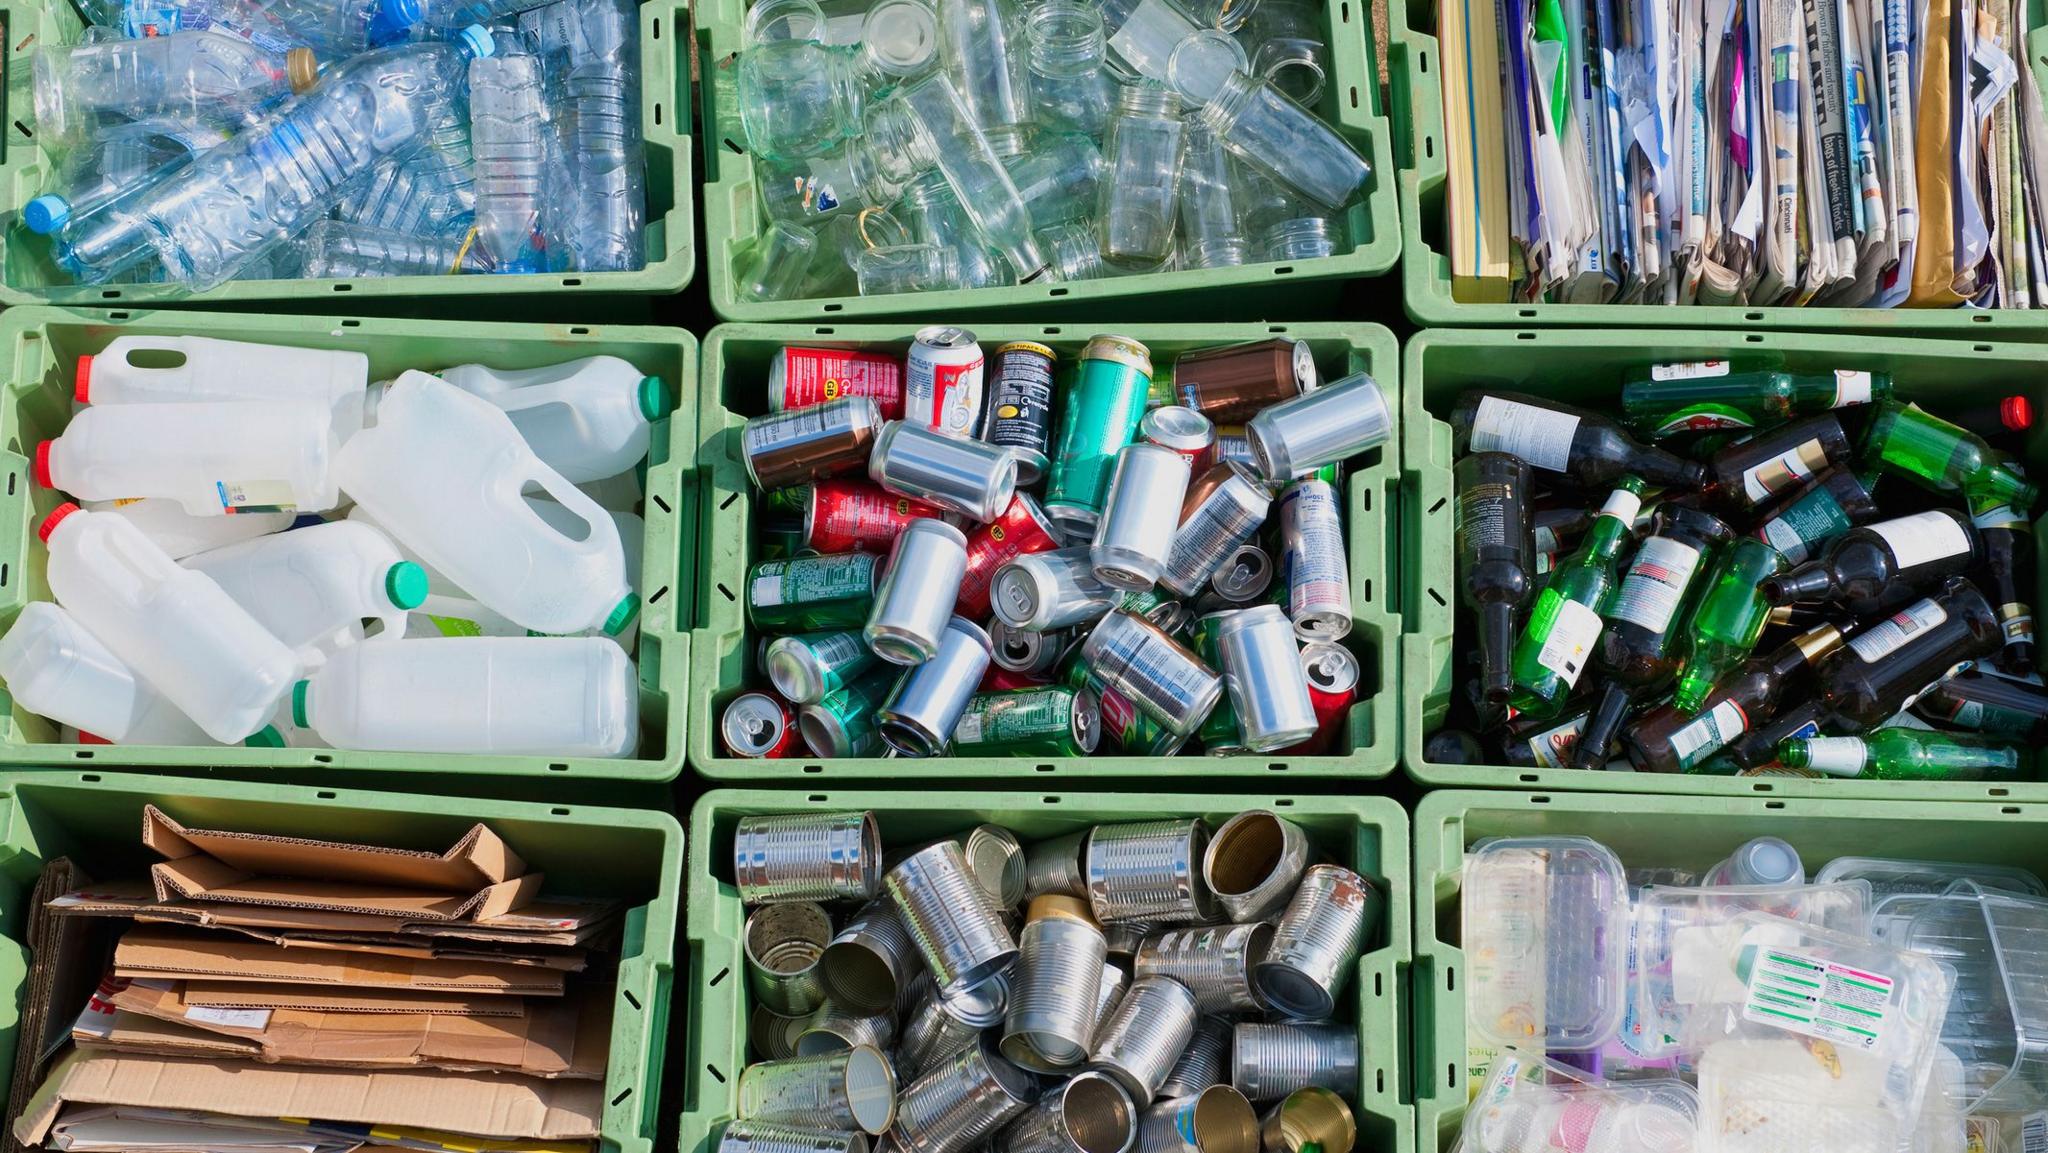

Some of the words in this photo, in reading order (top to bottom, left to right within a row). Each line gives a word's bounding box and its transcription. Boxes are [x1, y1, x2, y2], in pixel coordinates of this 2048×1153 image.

[1818, 1, 1827, 28] Brown
[557, 17, 569, 44] 500ml
[1822, 28, 1830, 36] of
[1825, 67, 1835, 83] and
[1824, 136, 1836, 159] bags
[1827, 159, 1838, 169] of
[1784, 198, 1792, 233] Cincinnati
[1833, 203, 1843, 231] frocks
[827, 380, 835, 397] GB
[898, 501, 908, 514] GB
[993, 527, 1004, 540] GB
